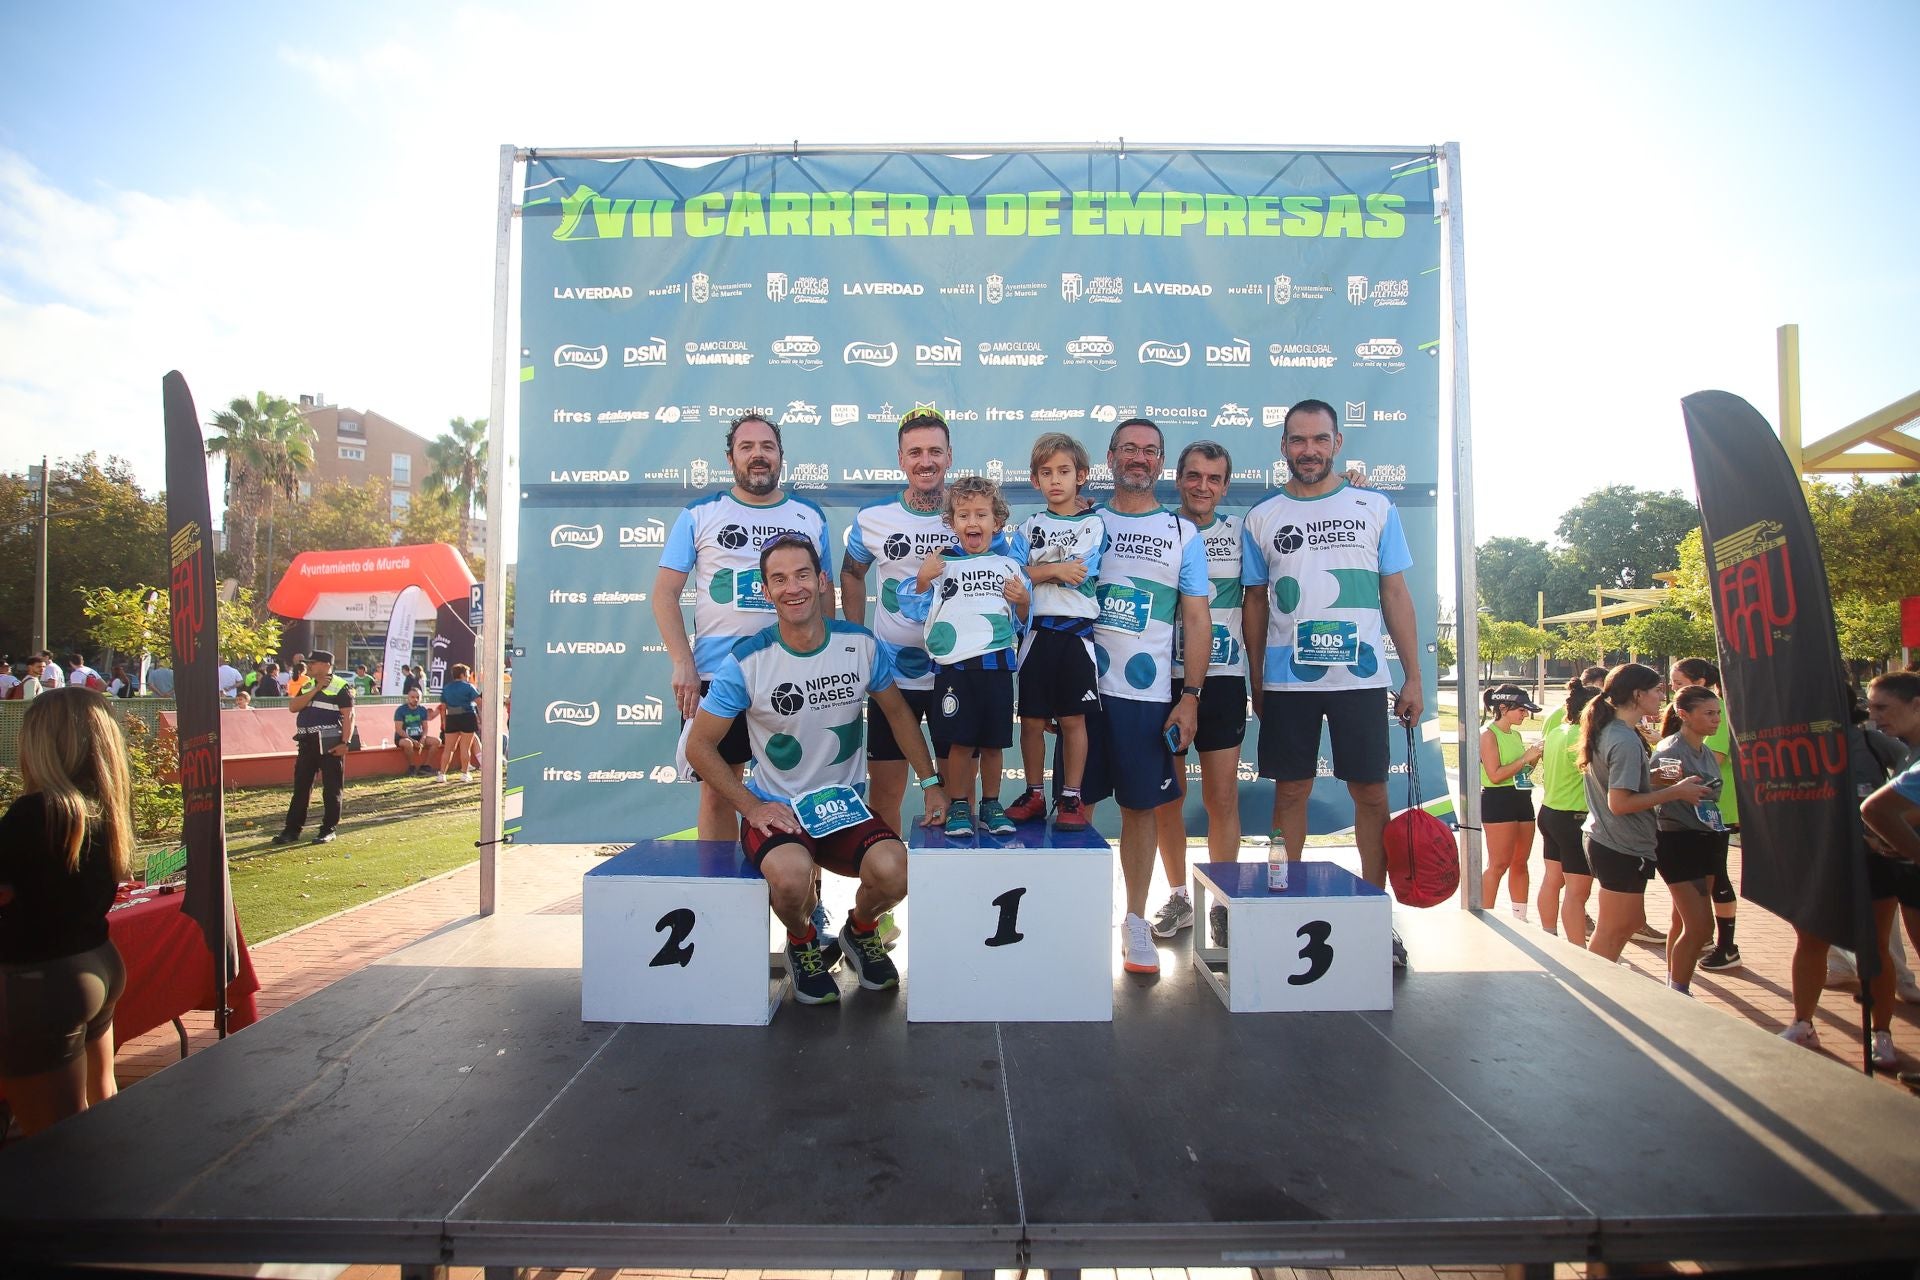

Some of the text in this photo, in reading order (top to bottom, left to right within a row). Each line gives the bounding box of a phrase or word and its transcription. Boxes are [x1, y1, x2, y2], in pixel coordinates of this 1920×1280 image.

[593, 191, 1406, 239] VII CARRERA DE EMPRESAS
[554, 286, 633, 300] LA VERDAD
[843, 283, 924, 296] LA VERDAD
[1133, 282, 1212, 296] LA VERDAD
[562, 351, 601, 363] VIDAL
[624, 344, 667, 363] DSM
[851, 349, 891, 360] VIDAL
[916, 345, 961, 361] DSM
[1145, 348, 1184, 360] VIDAL
[1206, 345, 1250, 362] DSM
[708, 405, 774, 417] Brocalsa
[944, 409, 979, 421] Hero
[1144, 405, 1208, 418] Brocalsa
[1373, 410, 1407, 421] Hero
[551, 470, 630, 482] LA VERDAD
[789, 473, 829, 481] ATLETISMO
[843, 469, 863, 481] LA
[1306, 519, 1366, 534] NIPPON
[558, 530, 595, 543] VIDAL
[619, 527, 665, 543] DSM
[915, 533, 960, 545] NIPPO
[1116, 532, 1173, 550] NIPPON
[1308, 531, 1356, 546] GASES
[1114, 542, 1162, 558] GASES
[300, 556, 411, 577] Ayuntamiento de Murcia
[961, 570, 1005, 586] NIPPO
[1104, 596, 1136, 616] 902
[546, 642, 626, 654] LA VERDAD
[1310, 633, 1344, 648] 908
[805, 671, 861, 692] NIPPON
[808, 686, 855, 705] GASES
[553, 707, 592, 719] VIDAL
[616, 703, 662, 720] DSM
[650, 765, 678, 784] 40
[815, 799, 848, 819] 903
[985, 887, 1026, 948] 1
[649, 908, 696, 968] 2
[1287, 920, 1334, 986] 3
